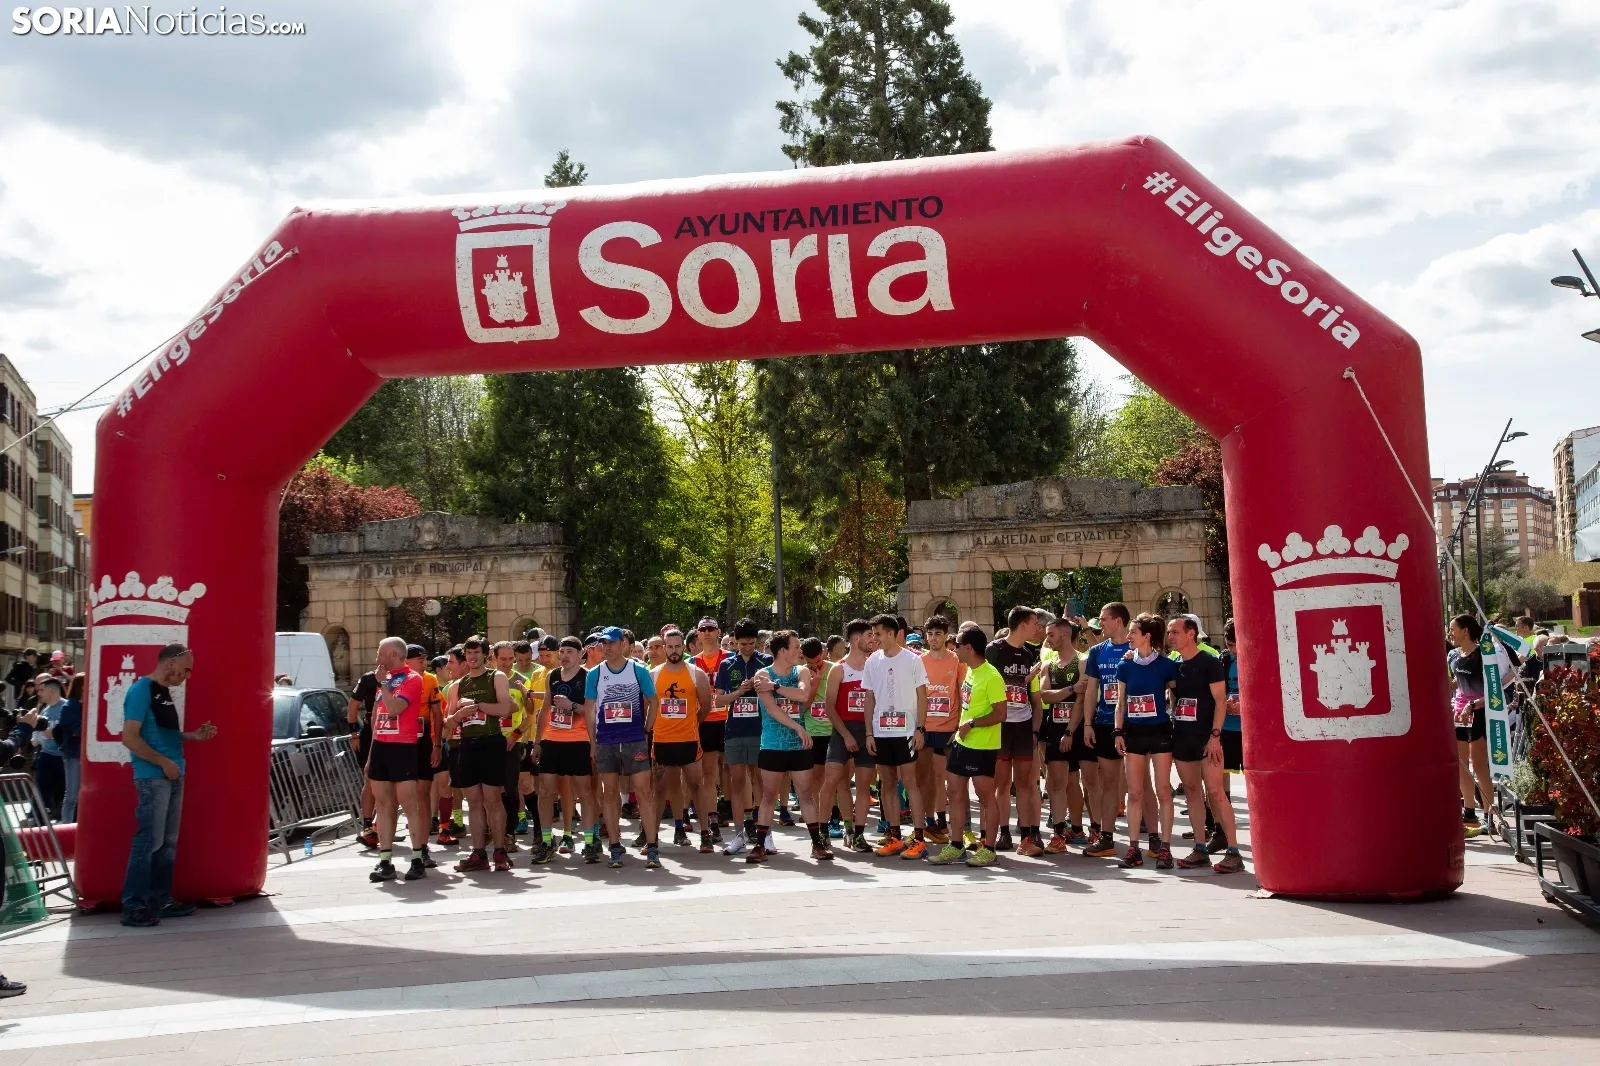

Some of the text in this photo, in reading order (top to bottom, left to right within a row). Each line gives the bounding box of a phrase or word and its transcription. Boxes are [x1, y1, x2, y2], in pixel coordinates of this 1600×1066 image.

[675, 196, 943, 240] AYUNTAMIENTO
[1143, 171, 1360, 349] #EligeSoria
[578, 221, 955, 336] Soria
[116, 239, 284, 418] #EligeSoria
[975, 529, 1132, 546] ALAMEDA DE CERVANTES
[377, 561, 486, 576] PARQUE MUNICIPAL
[1011, 692, 1022, 701] 13
[667, 705, 680, 713] 69
[736, 703, 754, 712] 120
[780, 705, 793, 713] 92
[930, 703, 943, 711] 57
[1133, 703, 1146, 712] 21
[1180, 706, 1185, 714] 1
[611, 709, 624, 718] 72
[1058, 709, 1070, 718] 91
[554, 714, 565, 723] 20
[885, 717, 899, 726] 85
[379, 720, 391, 729] 74
